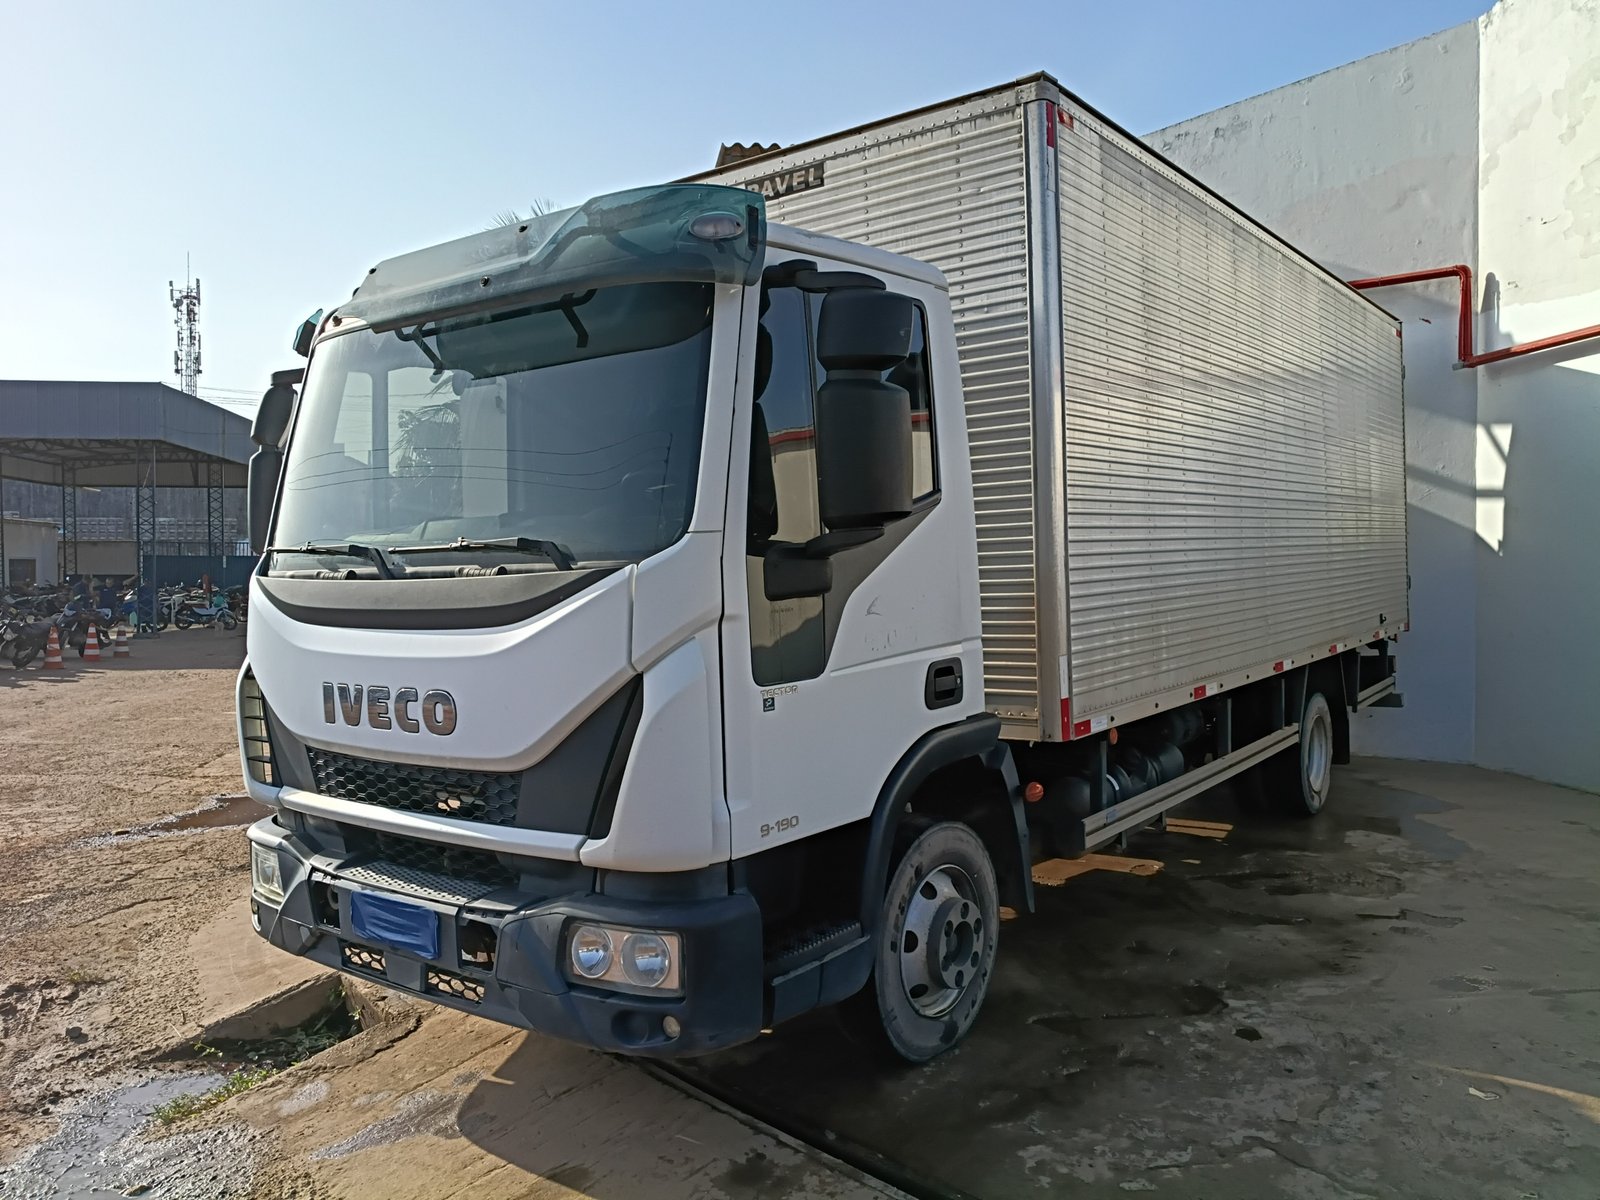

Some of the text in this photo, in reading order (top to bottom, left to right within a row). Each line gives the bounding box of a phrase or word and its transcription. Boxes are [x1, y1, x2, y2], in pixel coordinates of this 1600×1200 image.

[760, 685, 799, 699] TECTOR
[322, 682, 457, 736] IVECO
[760, 815, 799, 838] 9-190
